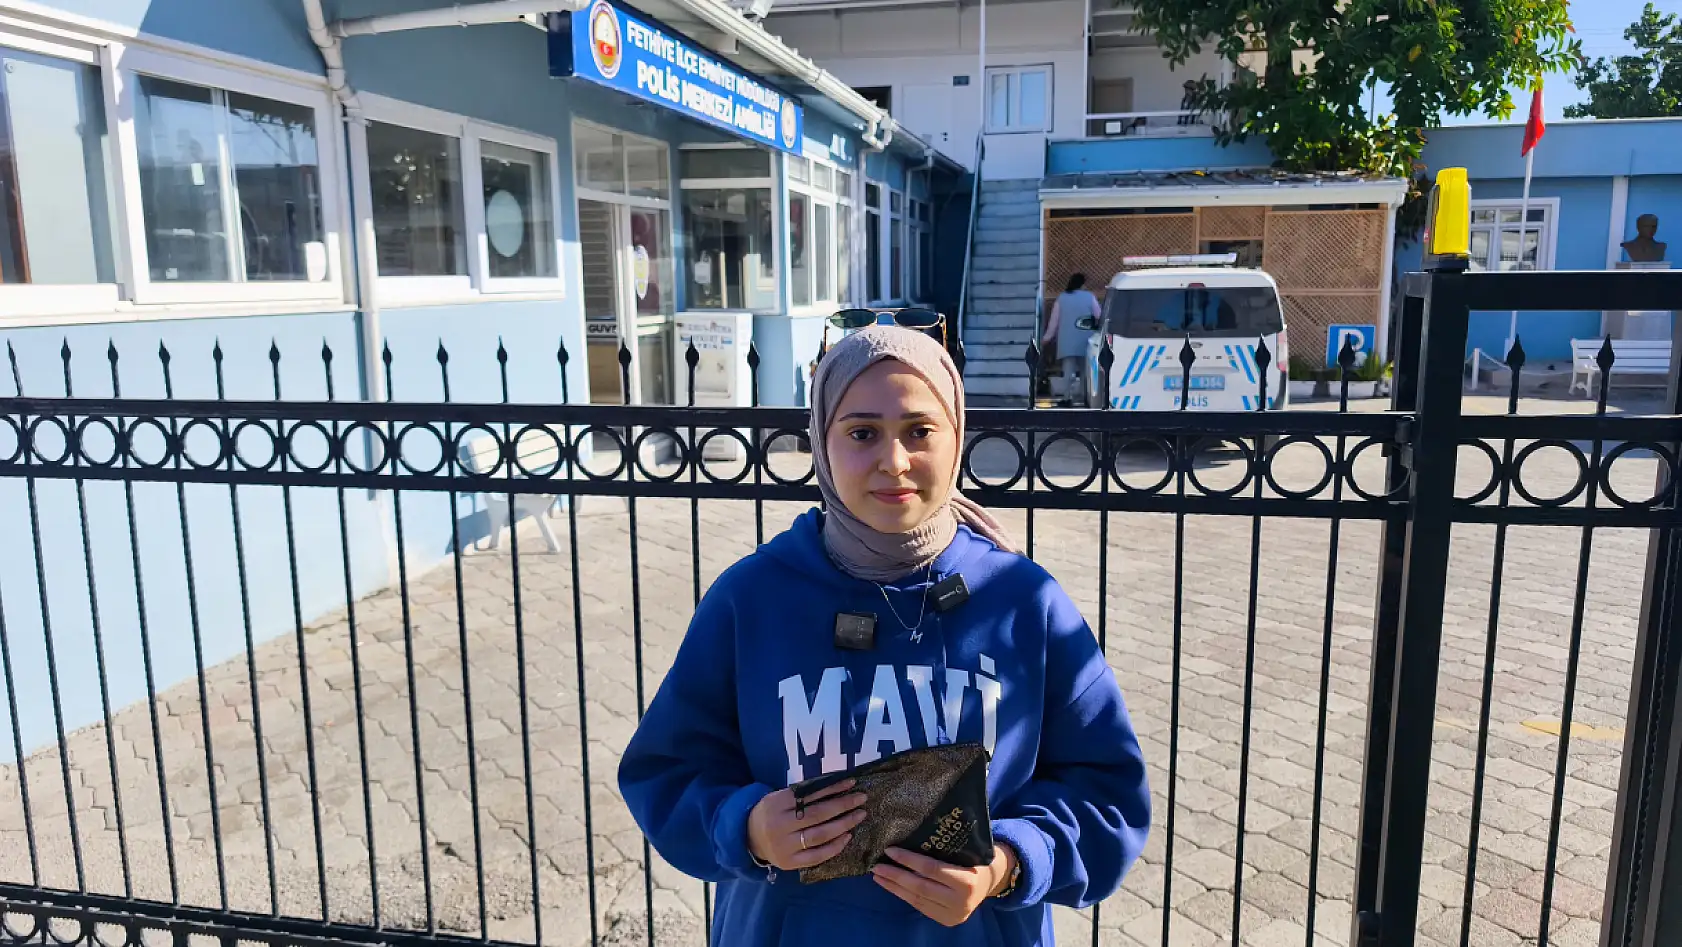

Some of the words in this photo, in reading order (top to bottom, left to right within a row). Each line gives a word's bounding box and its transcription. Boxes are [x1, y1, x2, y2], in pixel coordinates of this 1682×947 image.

[627, 20, 675, 63] FETHİYE
[675, 40, 698, 75] İLÇE
[637, 59, 680, 103] POLİS
[1337, 329, 1365, 365] P
[1174, 395, 1208, 407] PLİS
[778, 653, 1001, 786] MAVİ
[936, 821, 962, 850] GOLD
